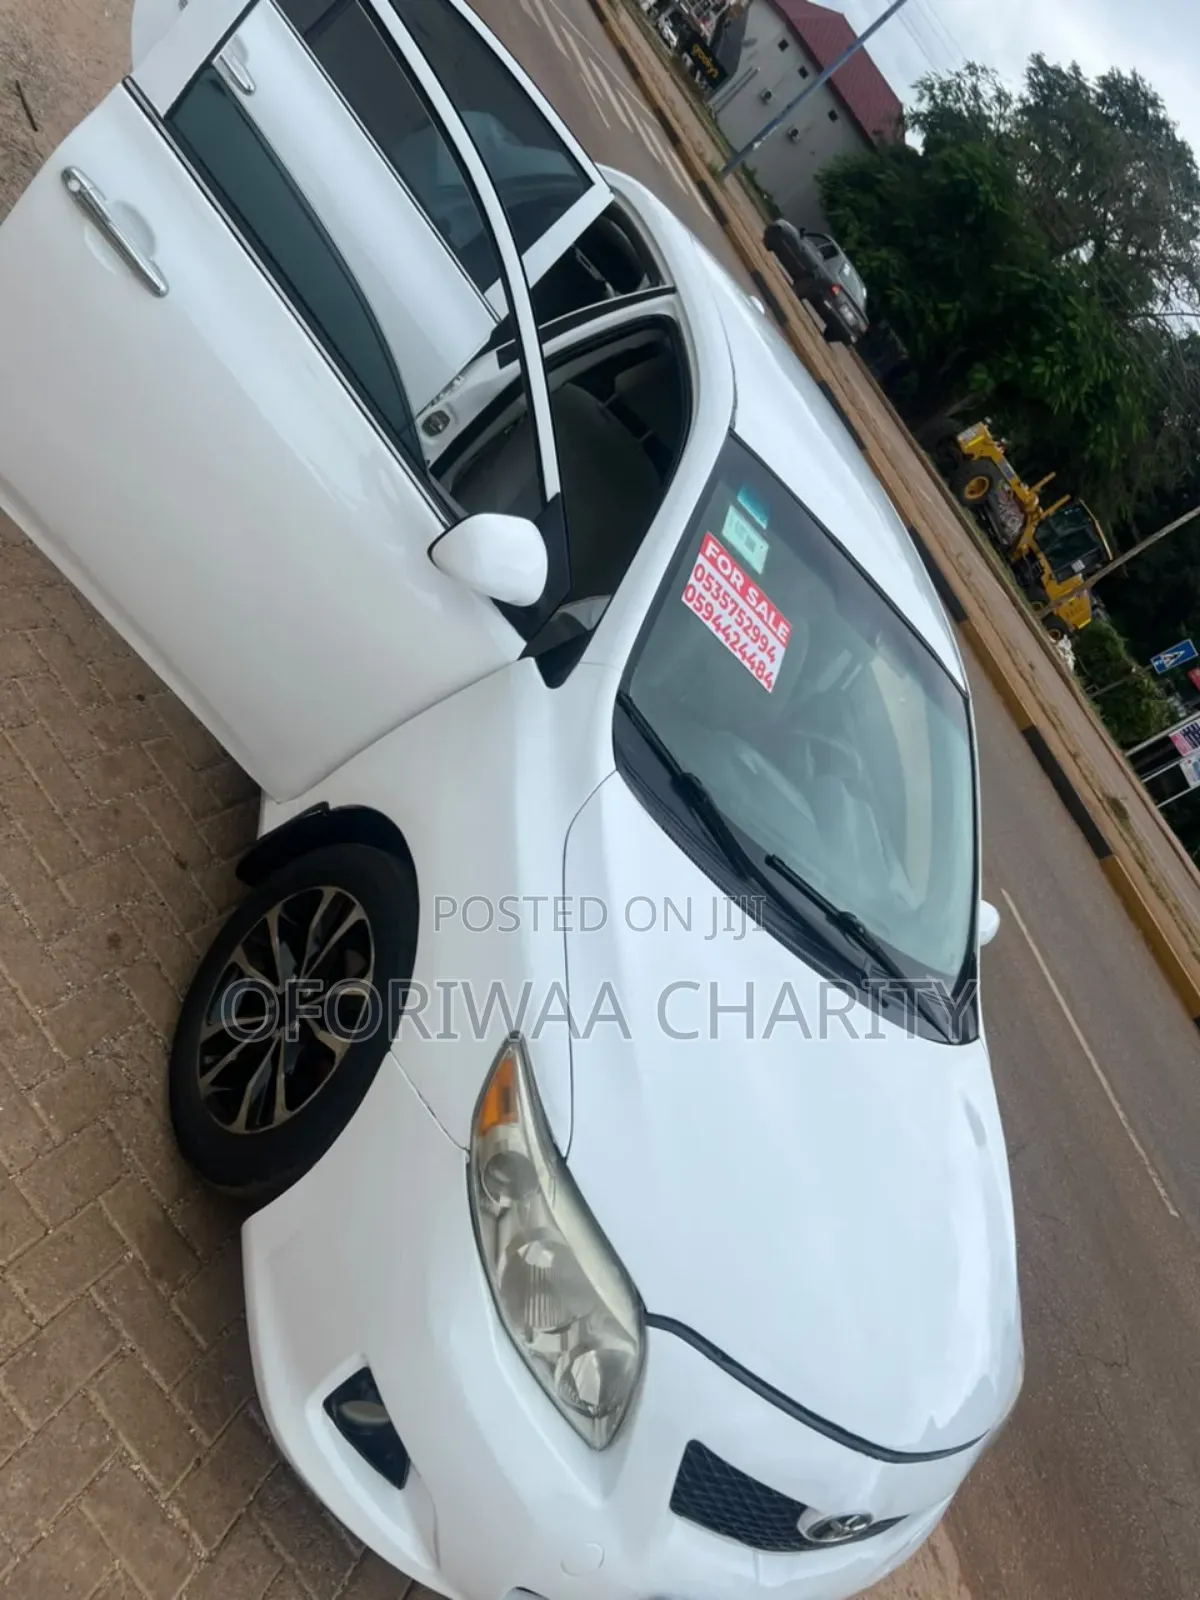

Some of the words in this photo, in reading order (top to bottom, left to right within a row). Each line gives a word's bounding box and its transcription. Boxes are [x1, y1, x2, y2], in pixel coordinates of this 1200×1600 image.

[684, 584, 774, 690] 0594424484
[693, 562, 776, 664] 0535752994
[703, 539, 744, 592] FOR
[745, 588, 790, 643] SALE
